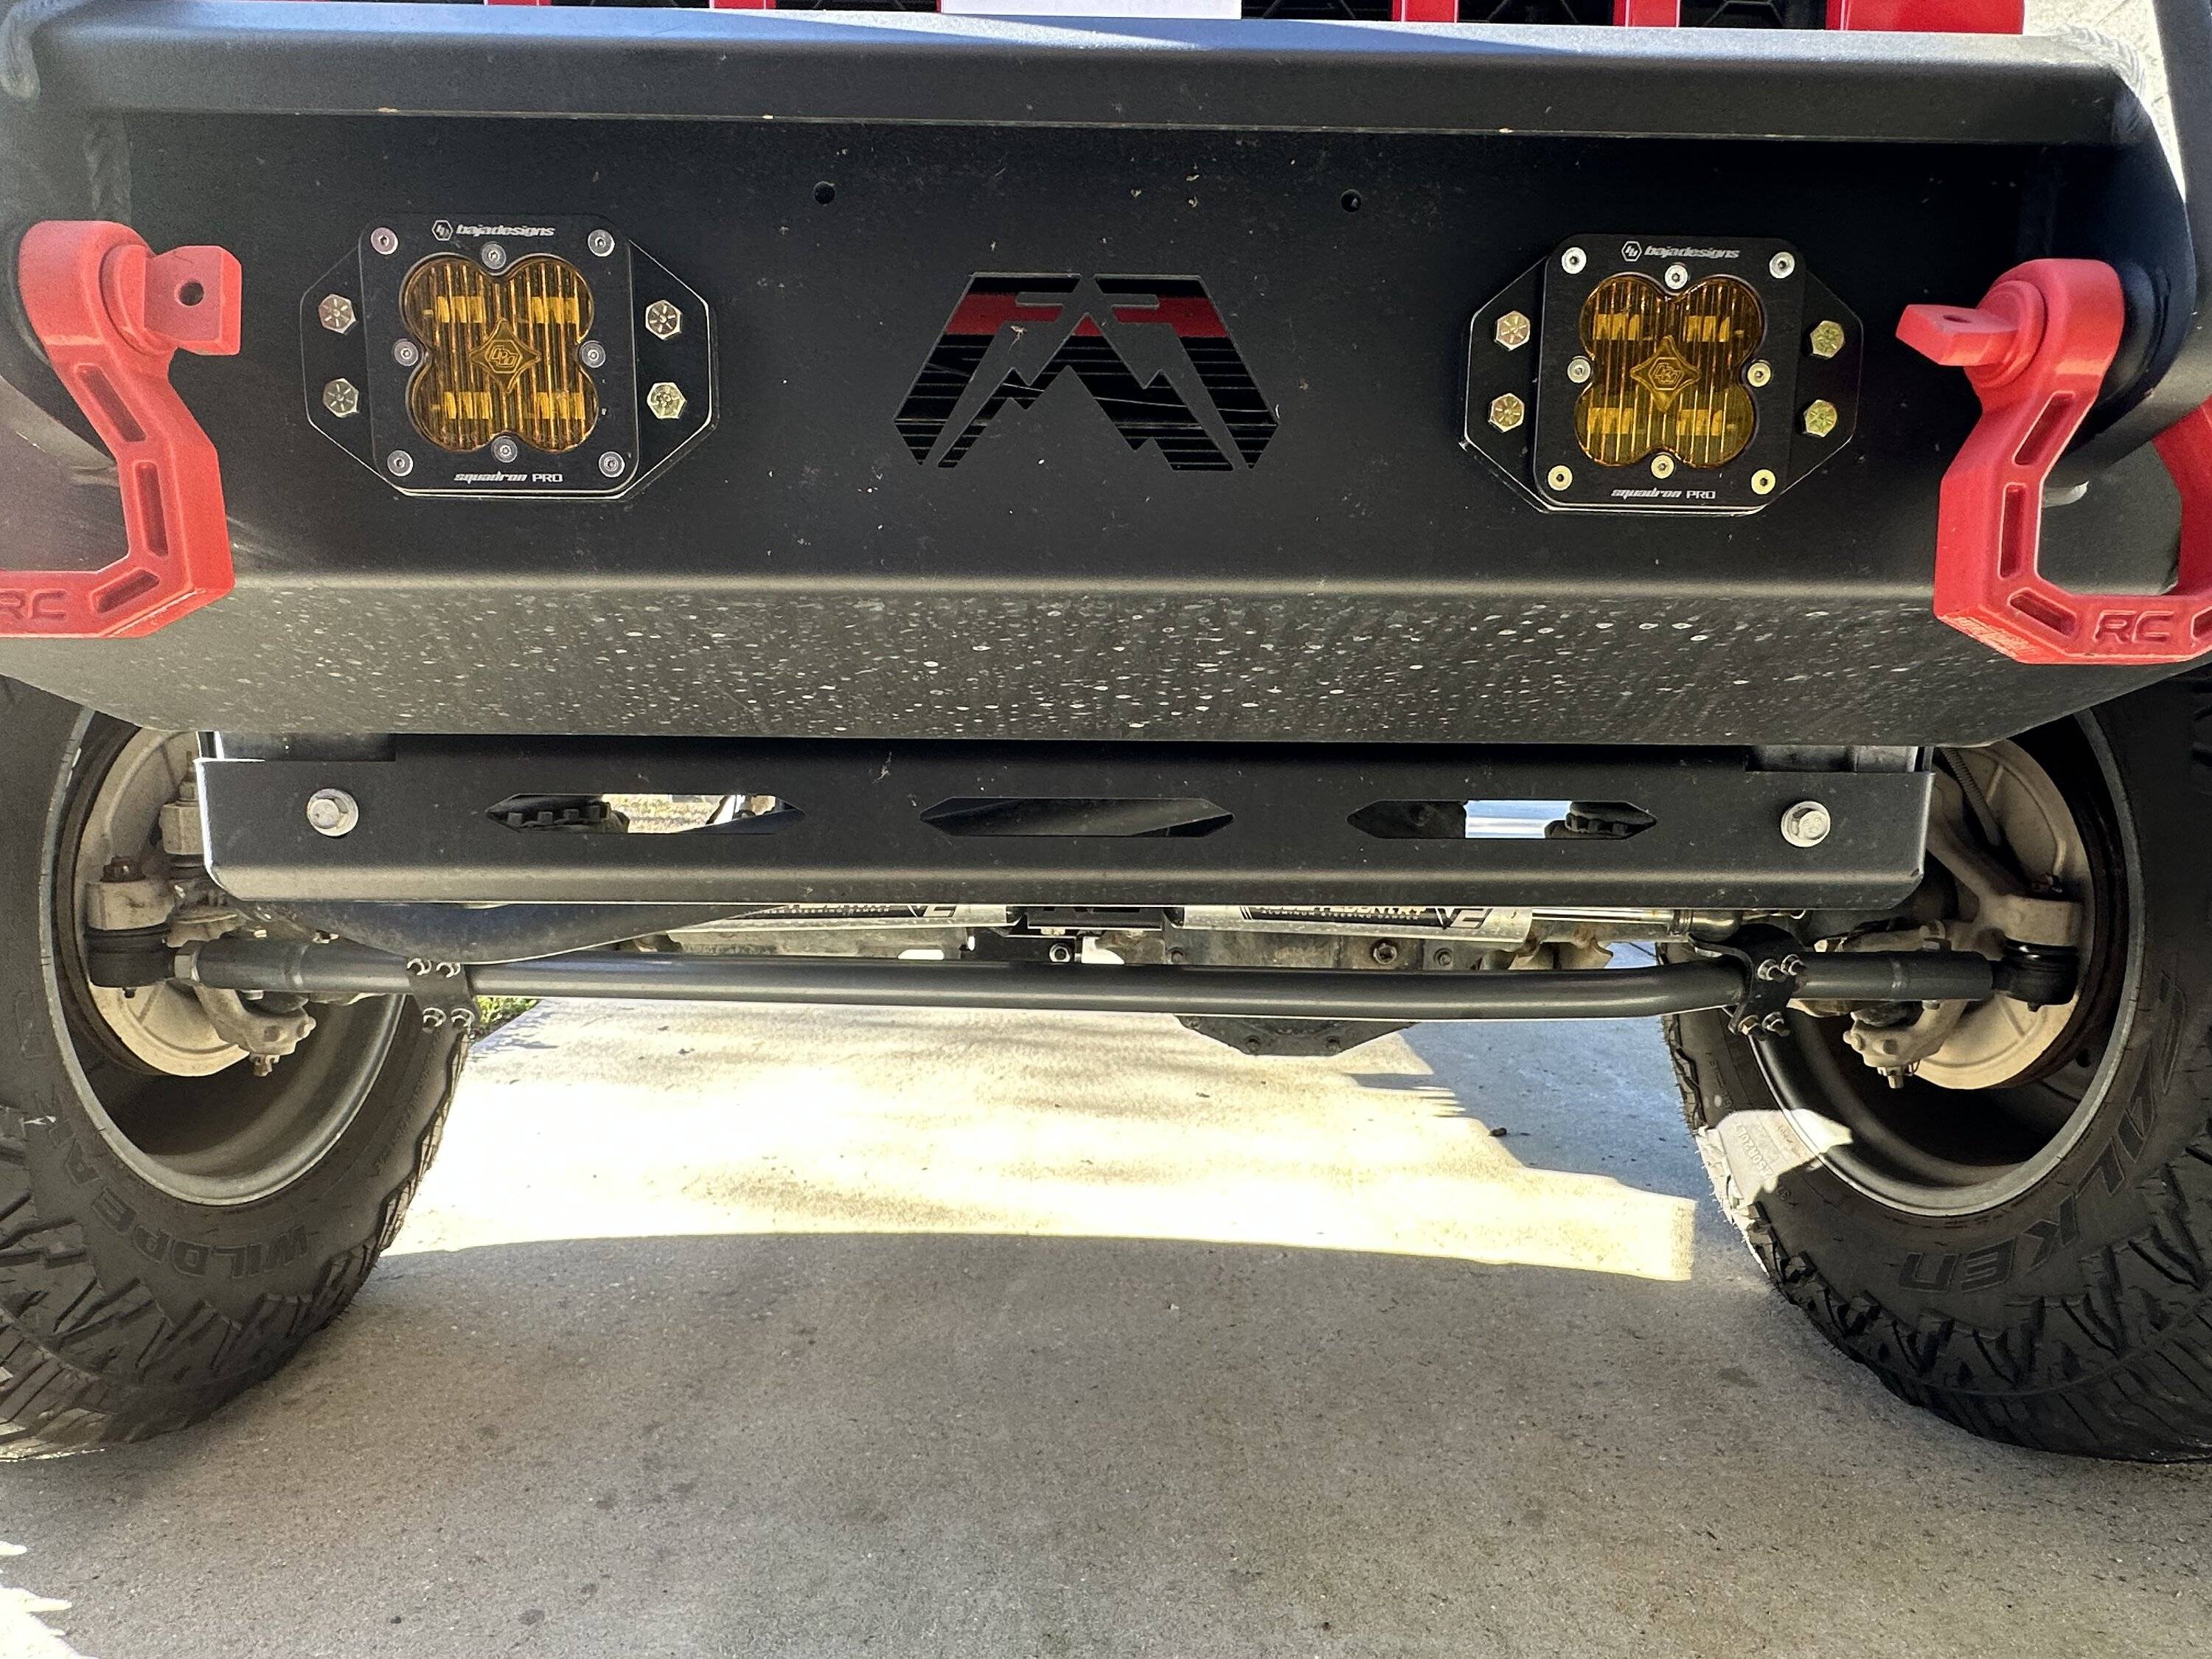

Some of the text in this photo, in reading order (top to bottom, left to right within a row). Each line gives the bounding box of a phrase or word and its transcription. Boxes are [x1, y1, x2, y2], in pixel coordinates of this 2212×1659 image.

[453, 470, 564, 484] squadron PRO
[1610, 487, 1717, 500] squadron PRO
[2093, 609, 2175, 644] RC
